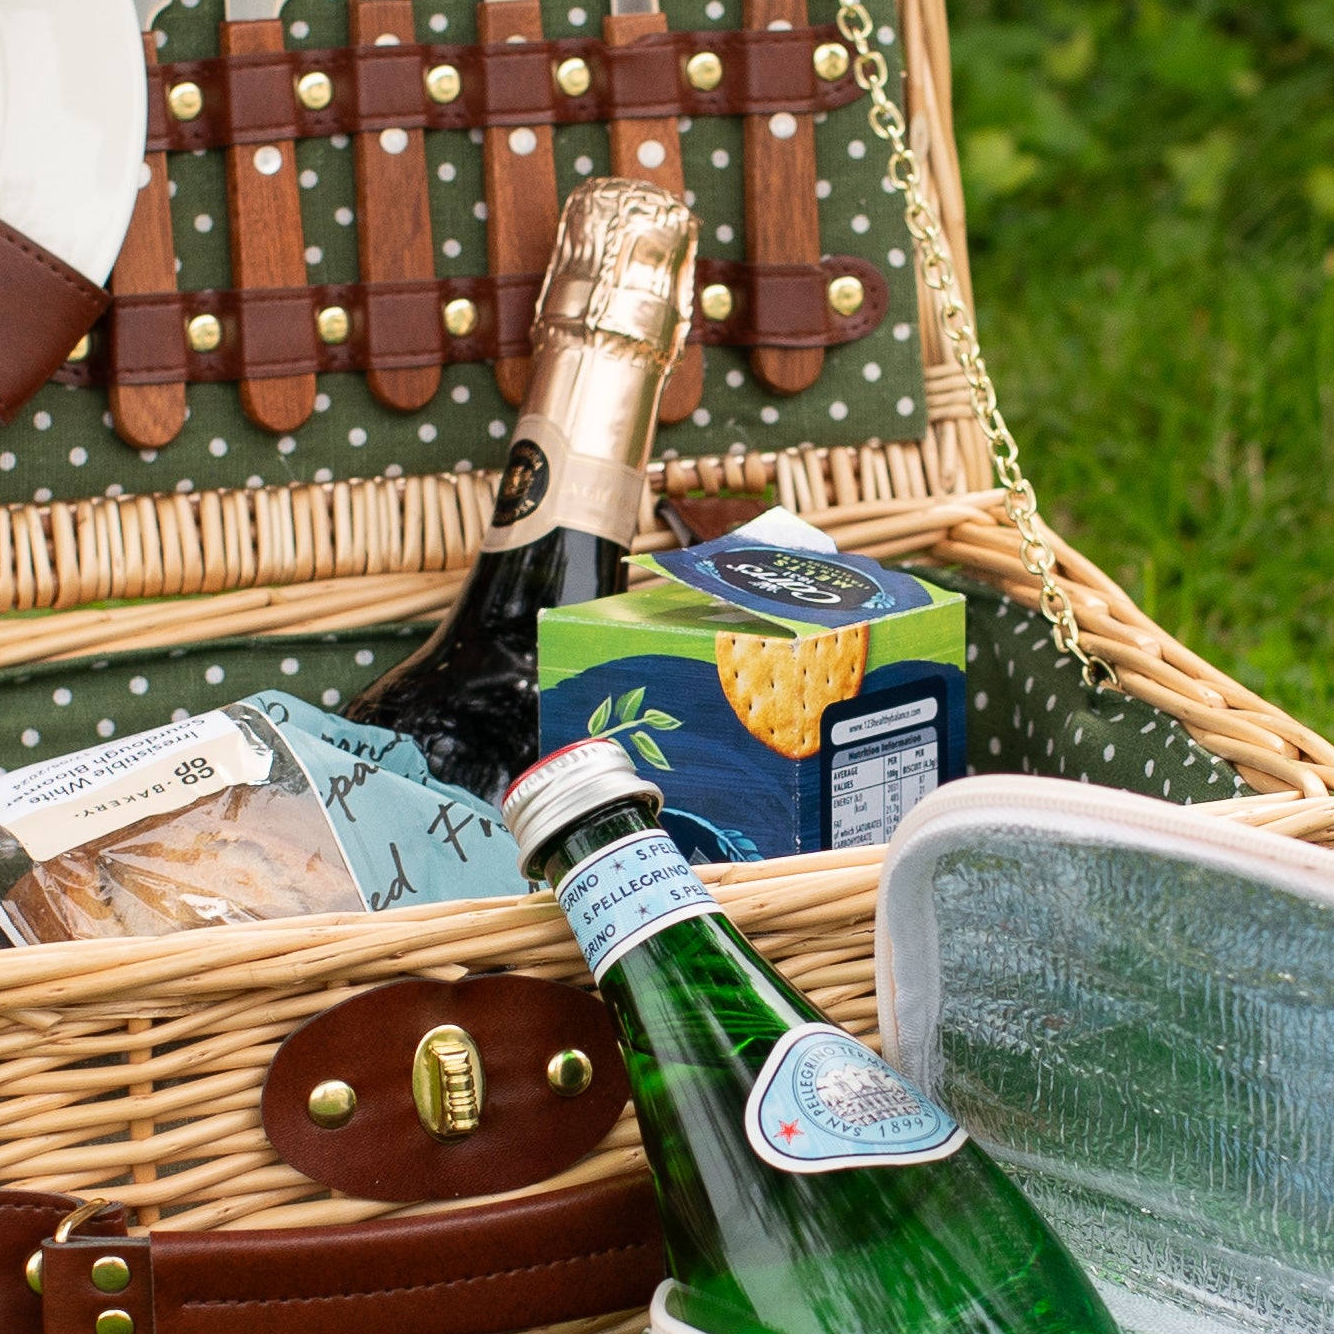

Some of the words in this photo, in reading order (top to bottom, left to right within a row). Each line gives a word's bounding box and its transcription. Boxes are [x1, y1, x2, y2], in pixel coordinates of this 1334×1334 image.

[773, 559, 853, 589] MELTS
[92, 719, 206, 766] Sourdough
[848, 744, 880, 761] Nutrition
[881, 734, 922, 752] Information
[93, 730, 199, 778] Irresistible
[887, 756, 898, 766] PER
[914, 748, 925, 759] PER
[833, 766, 859, 781] AVERAGE
[902, 761, 922, 775] BISCUIT
[5, 763, 90, 808] Bloomer
[28, 776, 93, 805] White
[833, 780, 854, 793] VALUES
[833, 796, 853, 809] ENERGY
[855, 818, 882, 833] SATURATES
[583, 864, 689, 926] S.PELLEGRINO
[800, 1046, 836, 1117] PELLEGRINO
[826, 1117, 862, 1137] SAN
[878, 1117, 924, 1138] 1899
